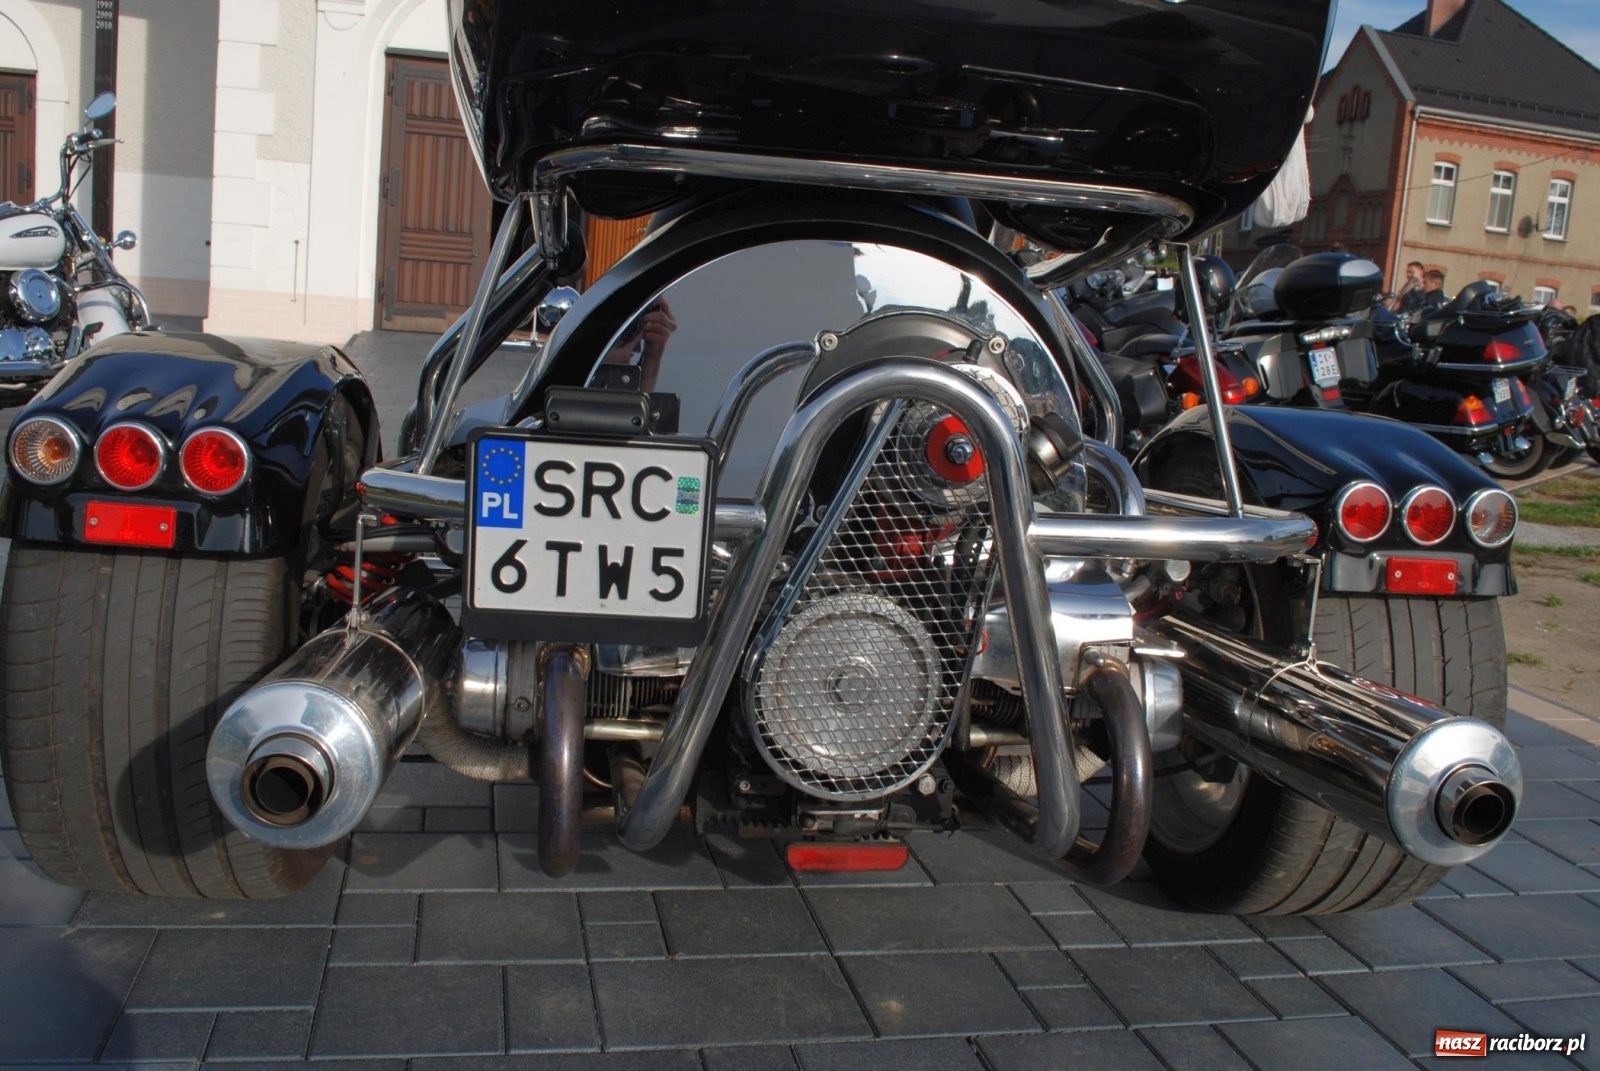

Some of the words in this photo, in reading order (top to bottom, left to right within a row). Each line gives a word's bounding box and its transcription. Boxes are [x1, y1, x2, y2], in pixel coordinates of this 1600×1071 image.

[481, 491, 519, 520] PL
[533, 459, 673, 522] SRC
[490, 538, 685, 602] 6TW5
